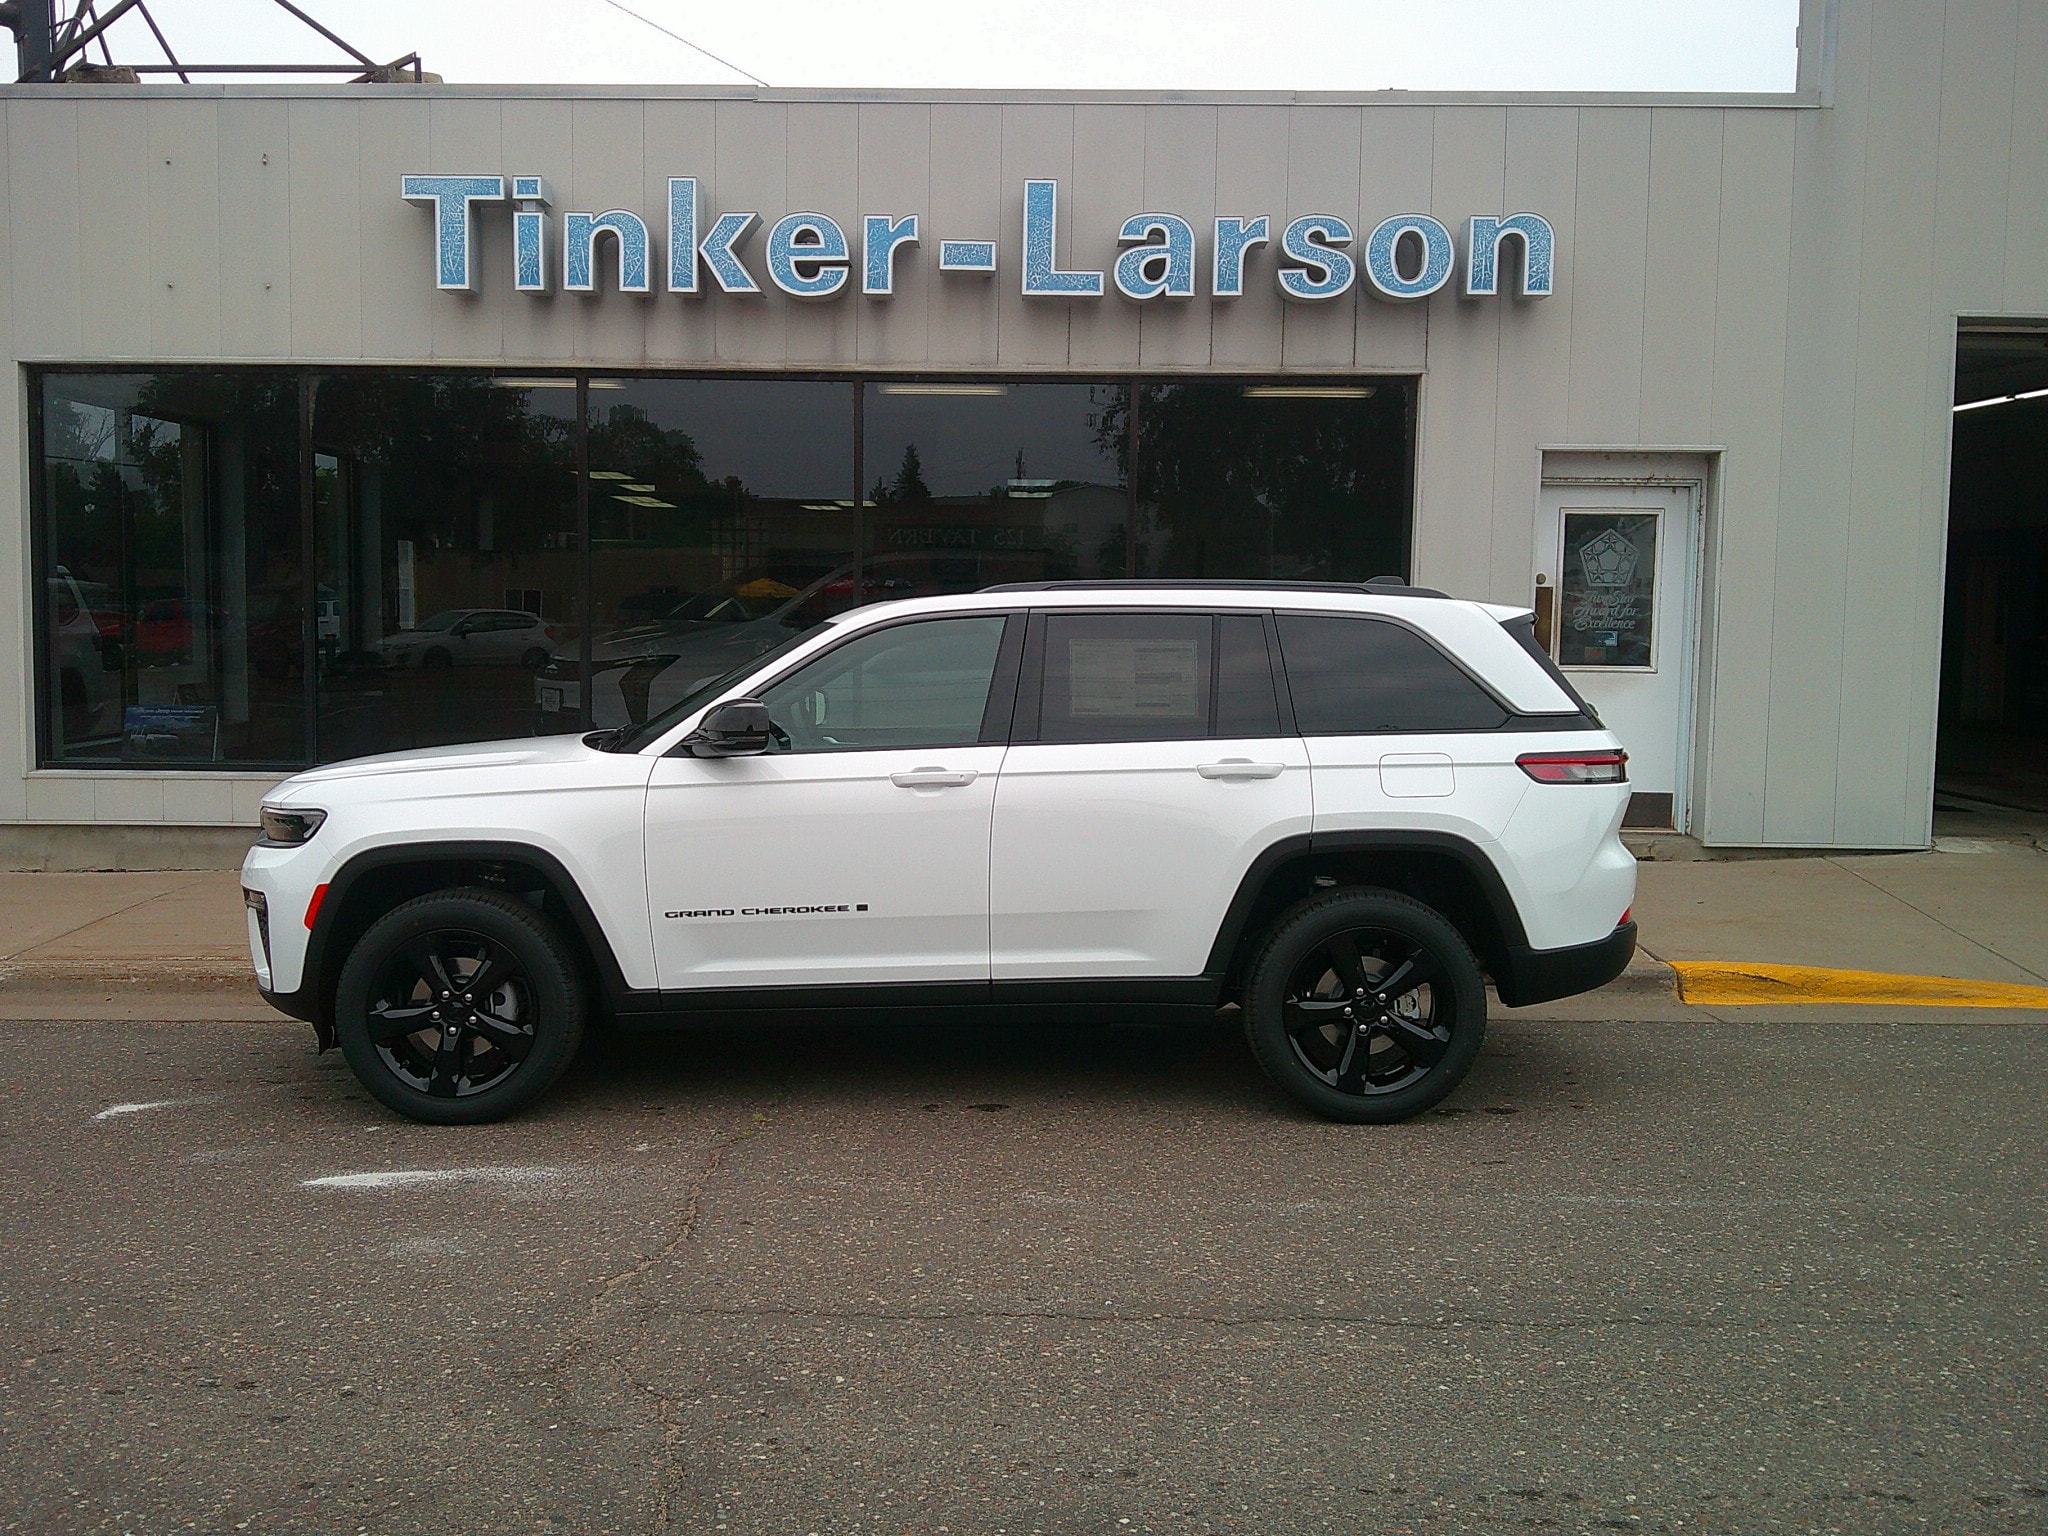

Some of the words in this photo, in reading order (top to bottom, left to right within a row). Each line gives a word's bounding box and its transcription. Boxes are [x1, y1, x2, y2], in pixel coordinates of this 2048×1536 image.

[400, 173, 1556, 301] Tinker-Larson
[1608, 590, 1637, 606] Star
[1572, 602, 1621, 617] Award
[1618, 603, 1640, 619] for
[1572, 615, 1637, 631] Excellence
[664, 908, 735, 919] GRAND
[741, 904, 850, 916] CHEROKEE
